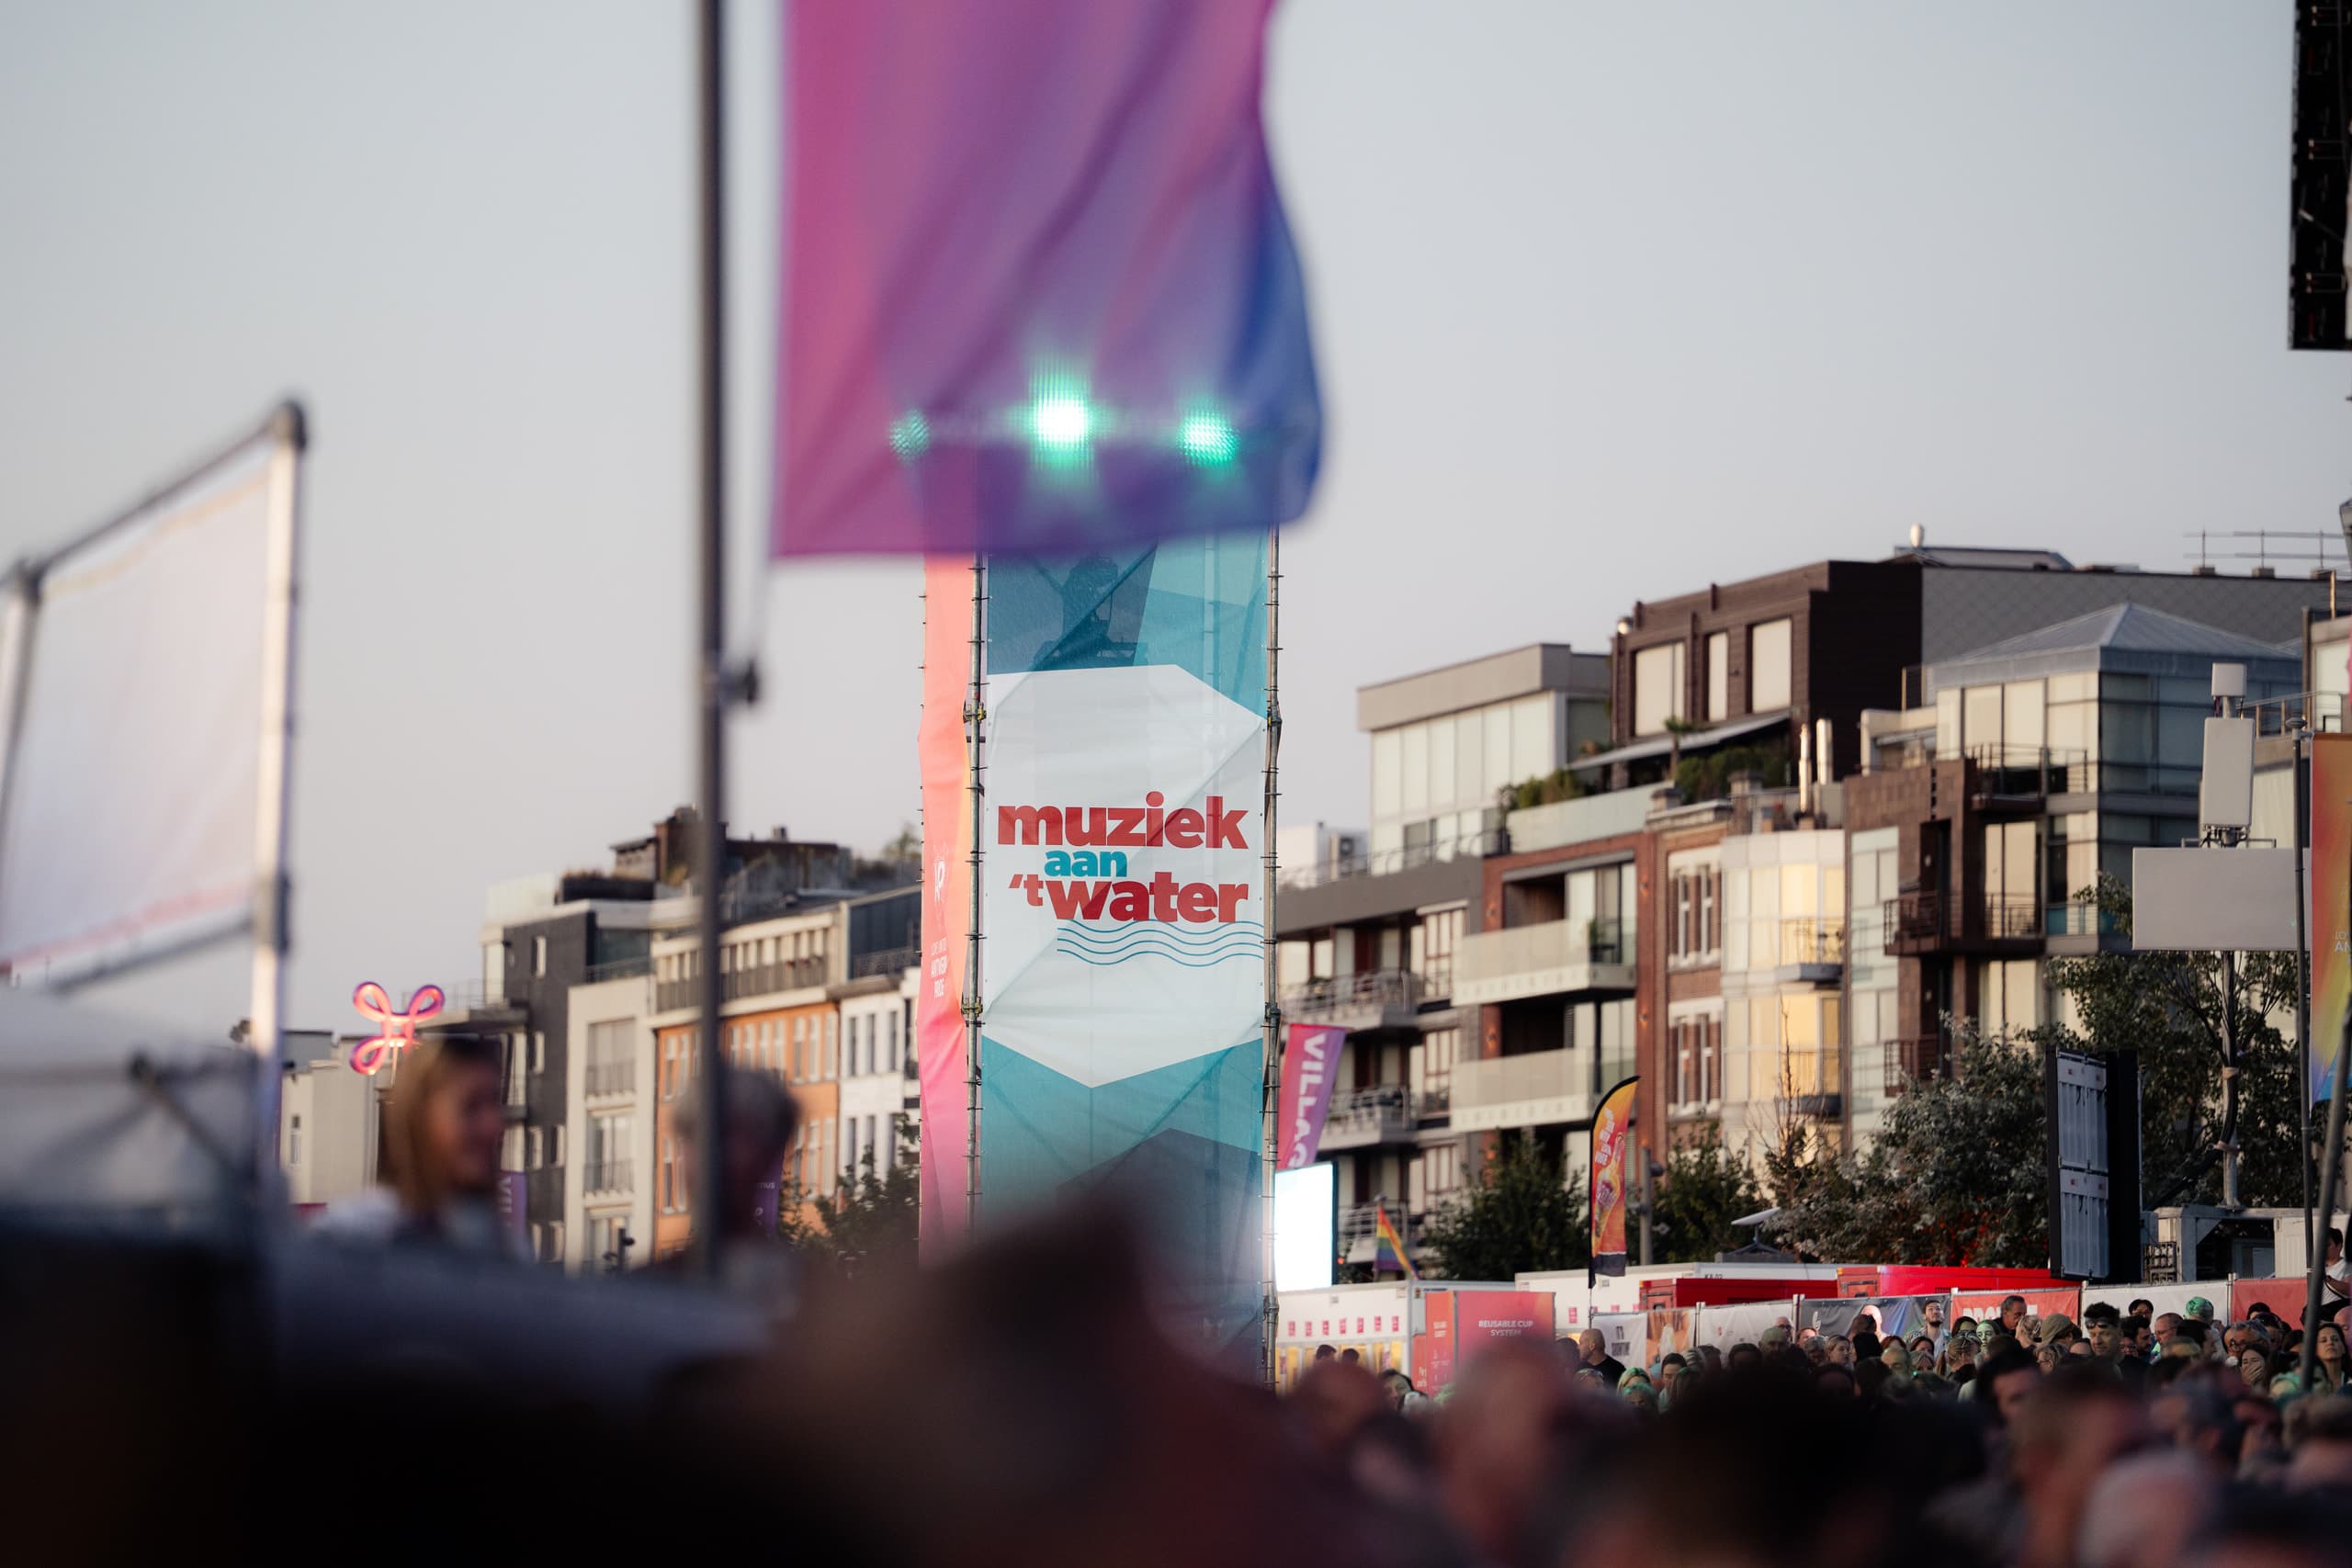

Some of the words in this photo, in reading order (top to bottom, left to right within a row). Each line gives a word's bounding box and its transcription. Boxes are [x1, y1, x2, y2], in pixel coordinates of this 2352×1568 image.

[998, 791, 1249, 849] muziek
[1045, 850, 1127, 877] aan
[1046, 872, 1249, 923] water
[1478, 1320, 1516, 1328] REUSABLE
[1517, 1320, 1533, 1328] CUP
